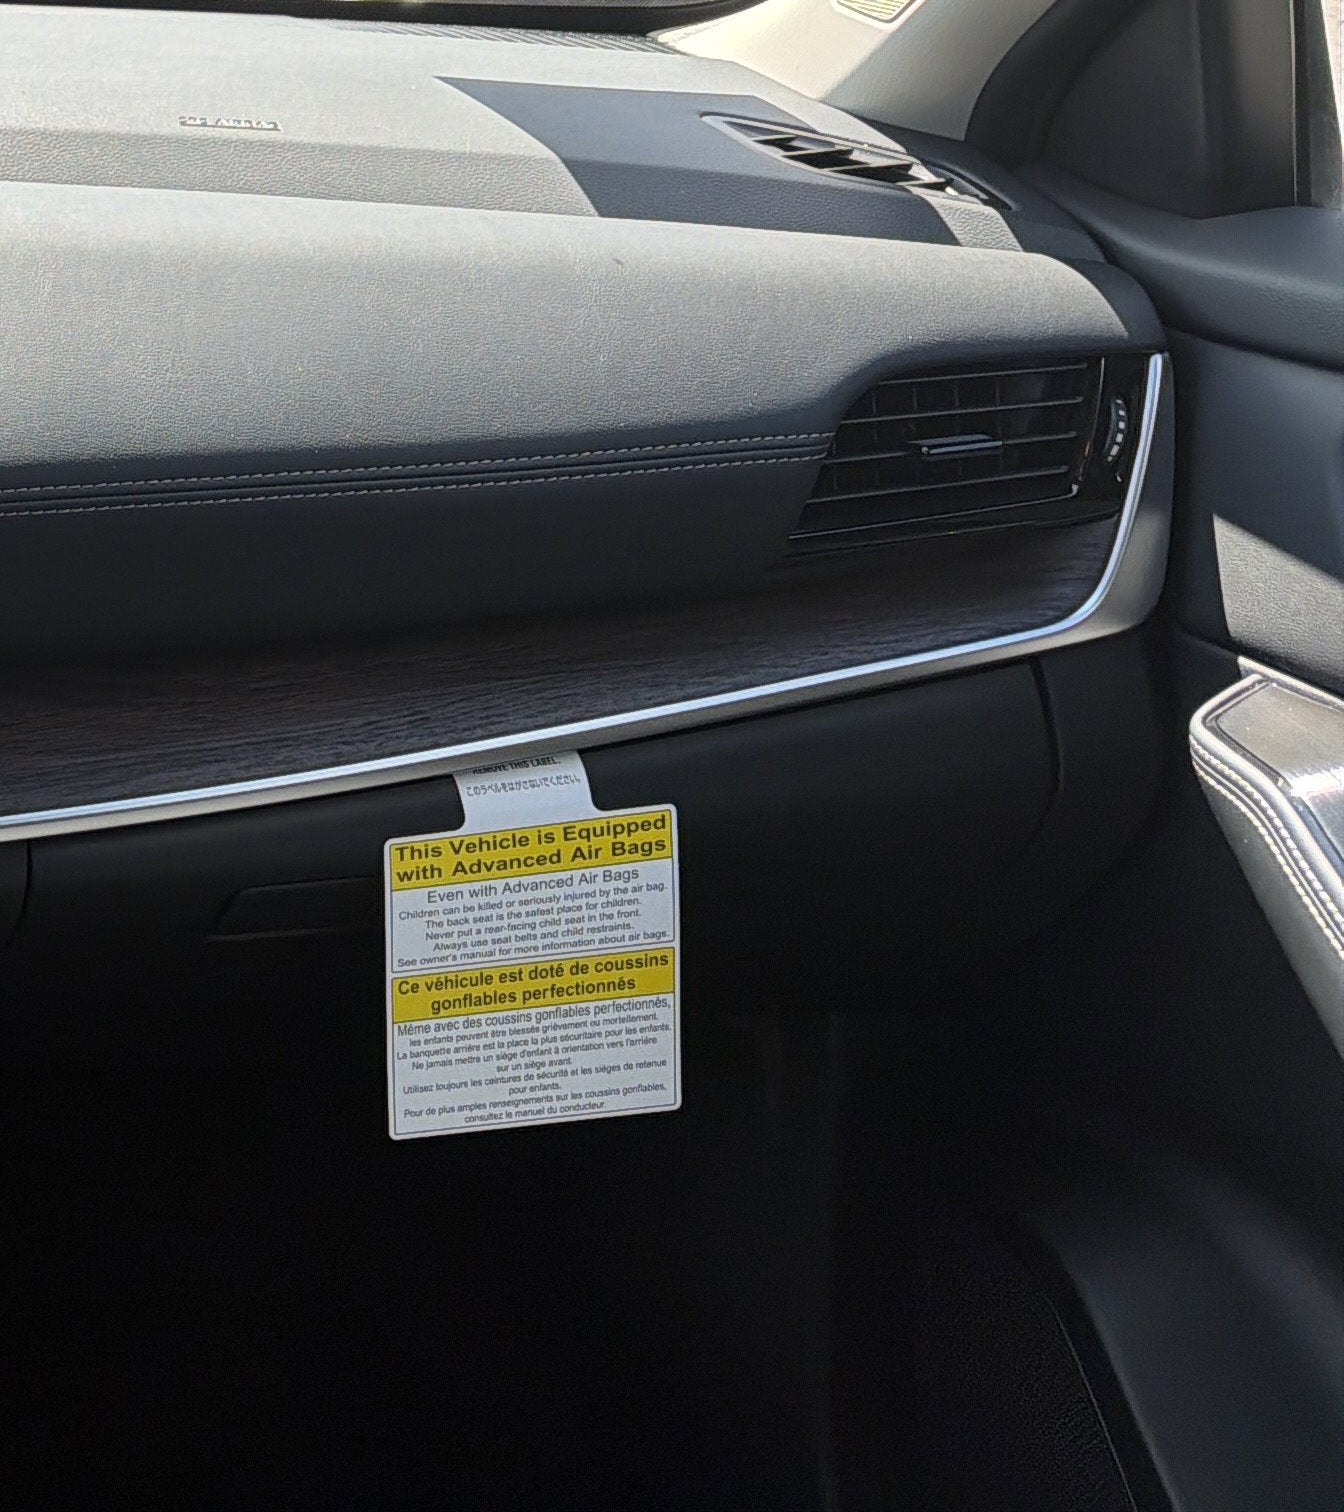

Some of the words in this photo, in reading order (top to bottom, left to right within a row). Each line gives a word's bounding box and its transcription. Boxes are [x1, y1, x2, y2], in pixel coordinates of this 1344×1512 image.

[395, 844, 442, 862] This
[449, 833, 529, 855] Vehicle
[537, 829, 555, 845] is
[563, 814, 666, 842] Equipped
[396, 864, 442, 882] with
[451, 849, 561, 876] Advanced
[570, 845, 602, 862] Air
[611, 839, 666, 856] Bags
[399, 909, 439, 920] Children
[442, 906, 460, 915] can
[463, 904, 475, 913] be
[478, 900, 503, 911] killed
[506, 899, 516, 908] or
[518, 894, 561, 907] seriously
[563, 890, 596, 902] injured
[599, 888, 610, 898] by
[613, 886, 628, 895] the
[631, 884, 643, 893] air
[646, 882, 668, 892] bag.
[427, 890, 463, 904] Even
[468, 885, 497, 898] with
[502, 874, 573, 895] Advanced
[578, 872, 598, 886] Air
[603, 869, 639, 883] Bags
[425, 919, 444, 929] The
[447, 916, 470, 927] back
[473, 914, 493, 924] seat
[496, 913, 504, 921] is
[507, 911, 522, 919] the
[525, 905, 553, 917] safest
[557, 903, 583, 916] place
[585, 901, 598, 911] for
[601, 897, 641, 909] children.
[398, 980, 420, 995] Ce
[424, 972, 493, 992] véhicule
[499, 968, 523, 983] est
[528, 963, 564, 980] doté
[570, 961, 589, 976] de
[594, 953, 669, 973] coussins
[431, 990, 517, 1014] gonflables
[522, 977, 636, 1005] perfectionnés
[398, 1024, 431, 1036] Même
[434, 1021, 460, 1033] avec
[462, 1017, 482, 1029] des
[485, 1012, 532, 1026] coussins
[535, 1006, 591, 1024] gonflables
